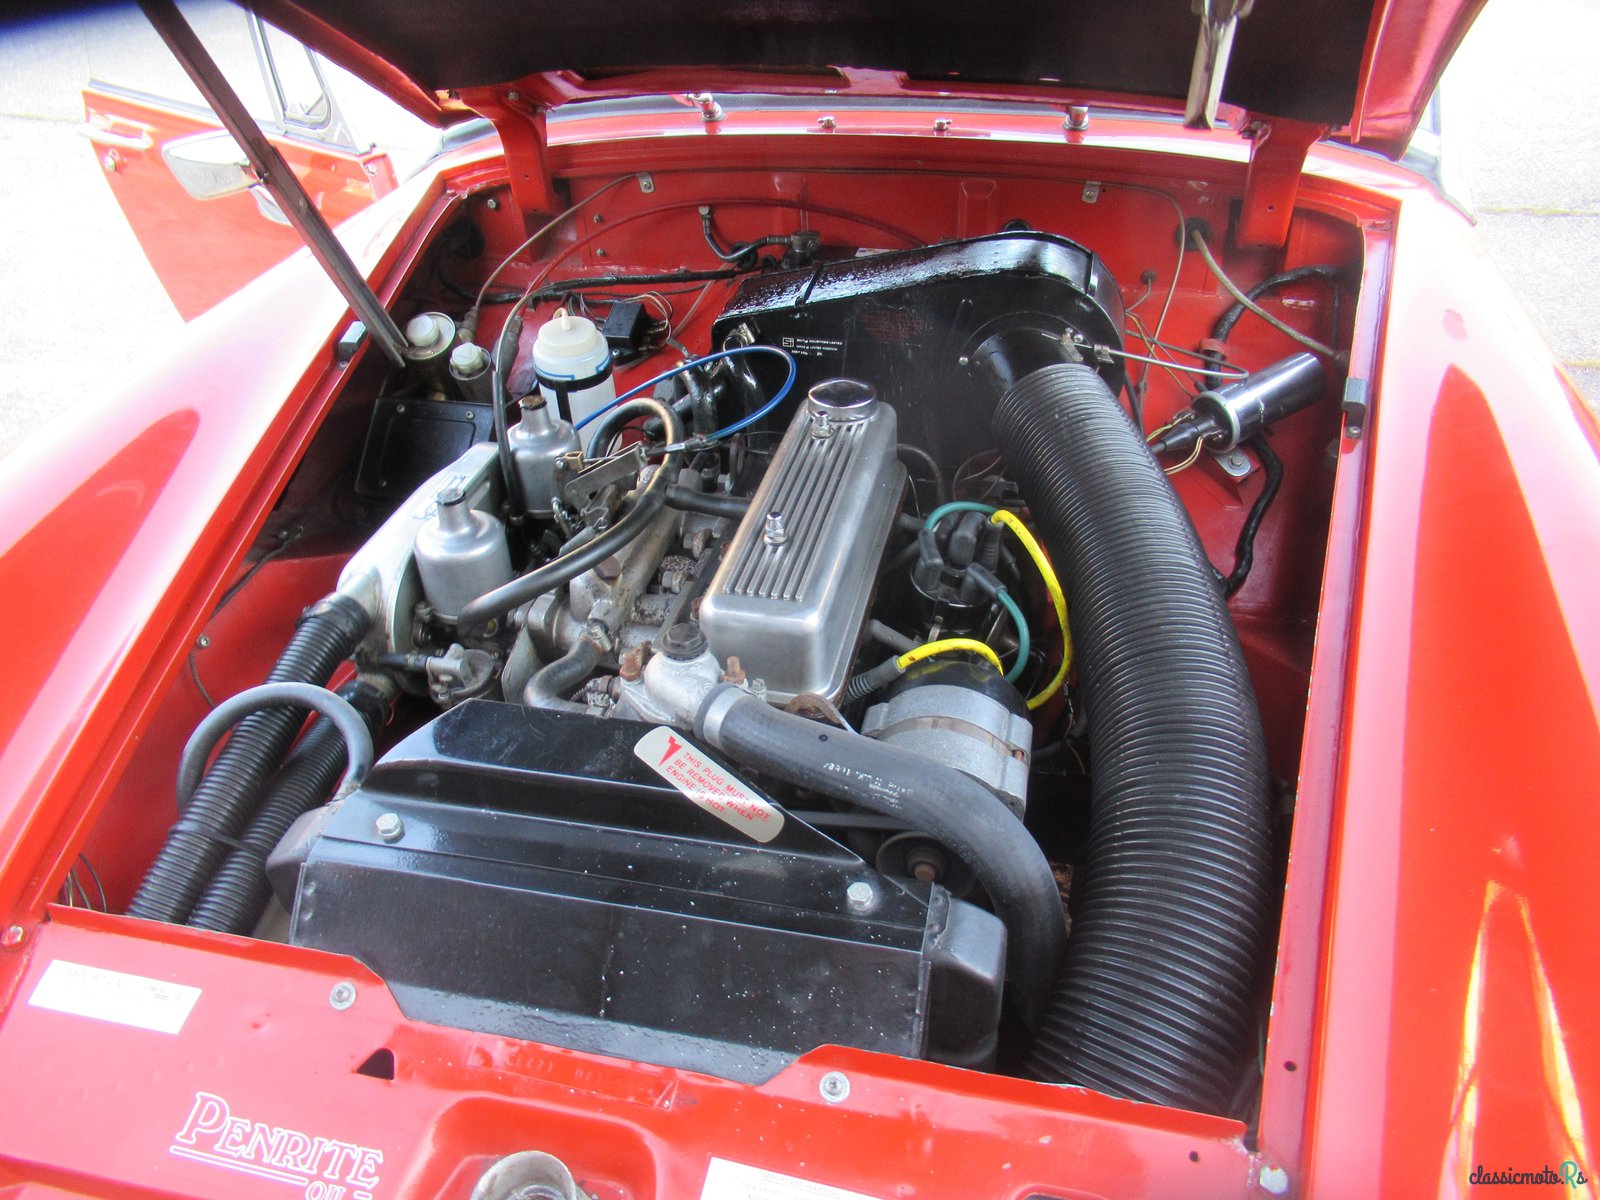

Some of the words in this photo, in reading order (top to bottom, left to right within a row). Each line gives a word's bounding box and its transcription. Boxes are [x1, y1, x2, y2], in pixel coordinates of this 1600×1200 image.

[666, 766, 697, 791] ENGINE
[697, 789, 705, 800] IS
[705, 798, 726, 814] HOT
[674, 759, 685, 770] BE
[687, 768, 725, 801] REMOVED
[726, 801, 753, 821] WHEN
[683, 752, 702, 769] THIS
[703, 767, 724, 786] PLUG
[725, 785, 749, 802] MUST
